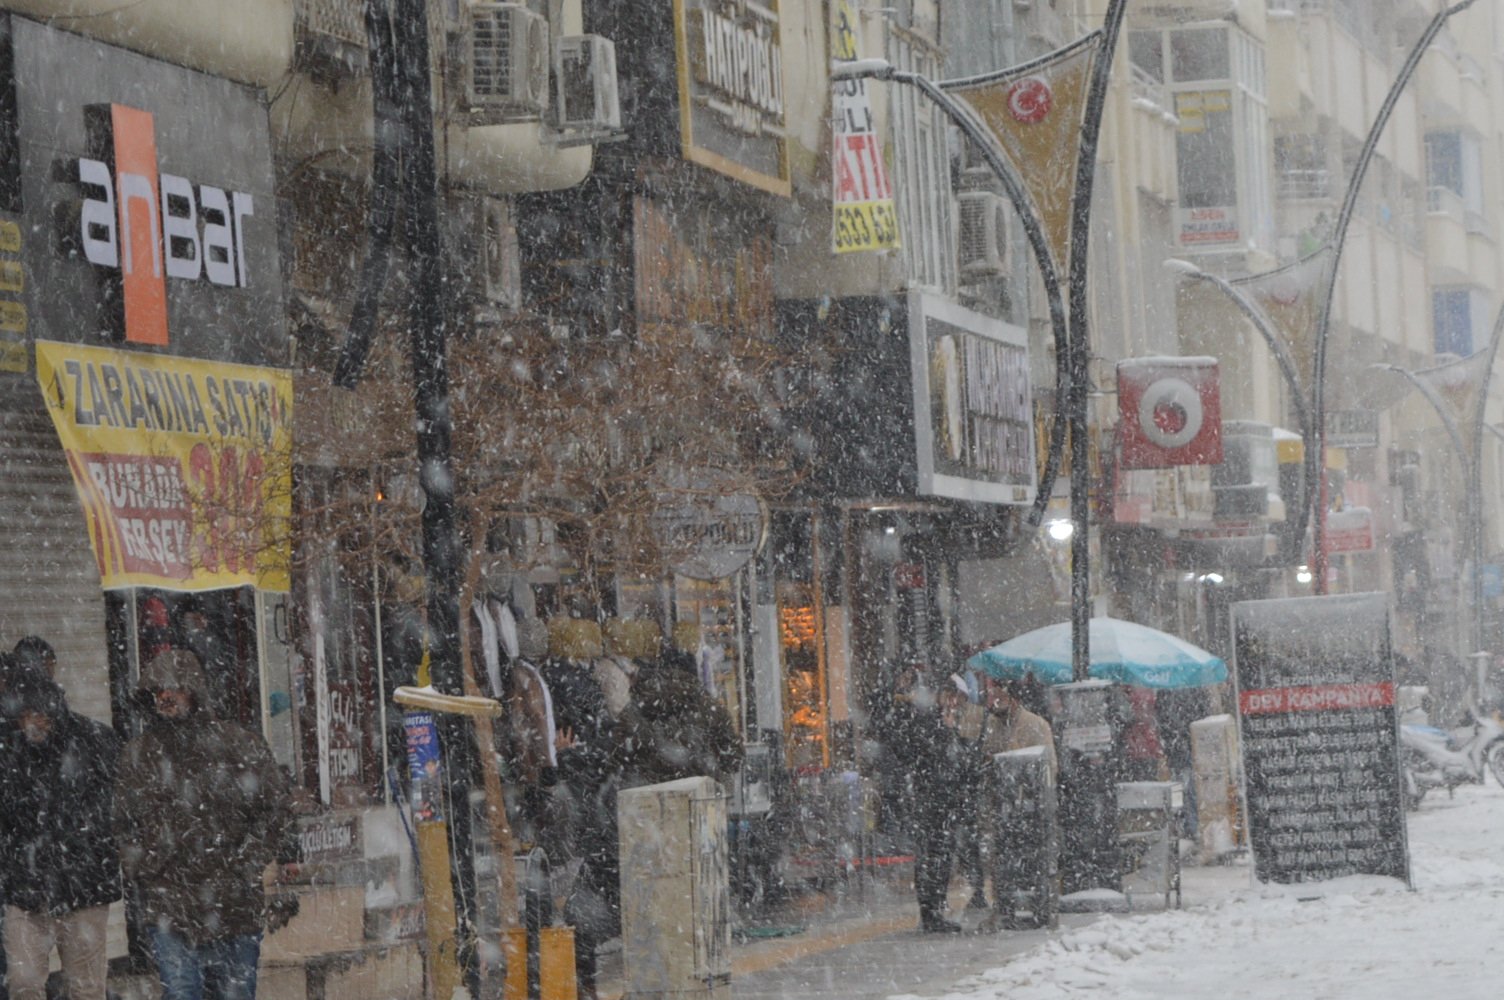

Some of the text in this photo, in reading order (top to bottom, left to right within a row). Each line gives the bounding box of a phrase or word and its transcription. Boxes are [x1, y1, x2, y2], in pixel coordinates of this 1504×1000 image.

[64, 360, 210, 434] ZARARINA
[88, 462, 186, 510] BURADA
[1248, 687, 1381, 709] DEV KAMPANYA
